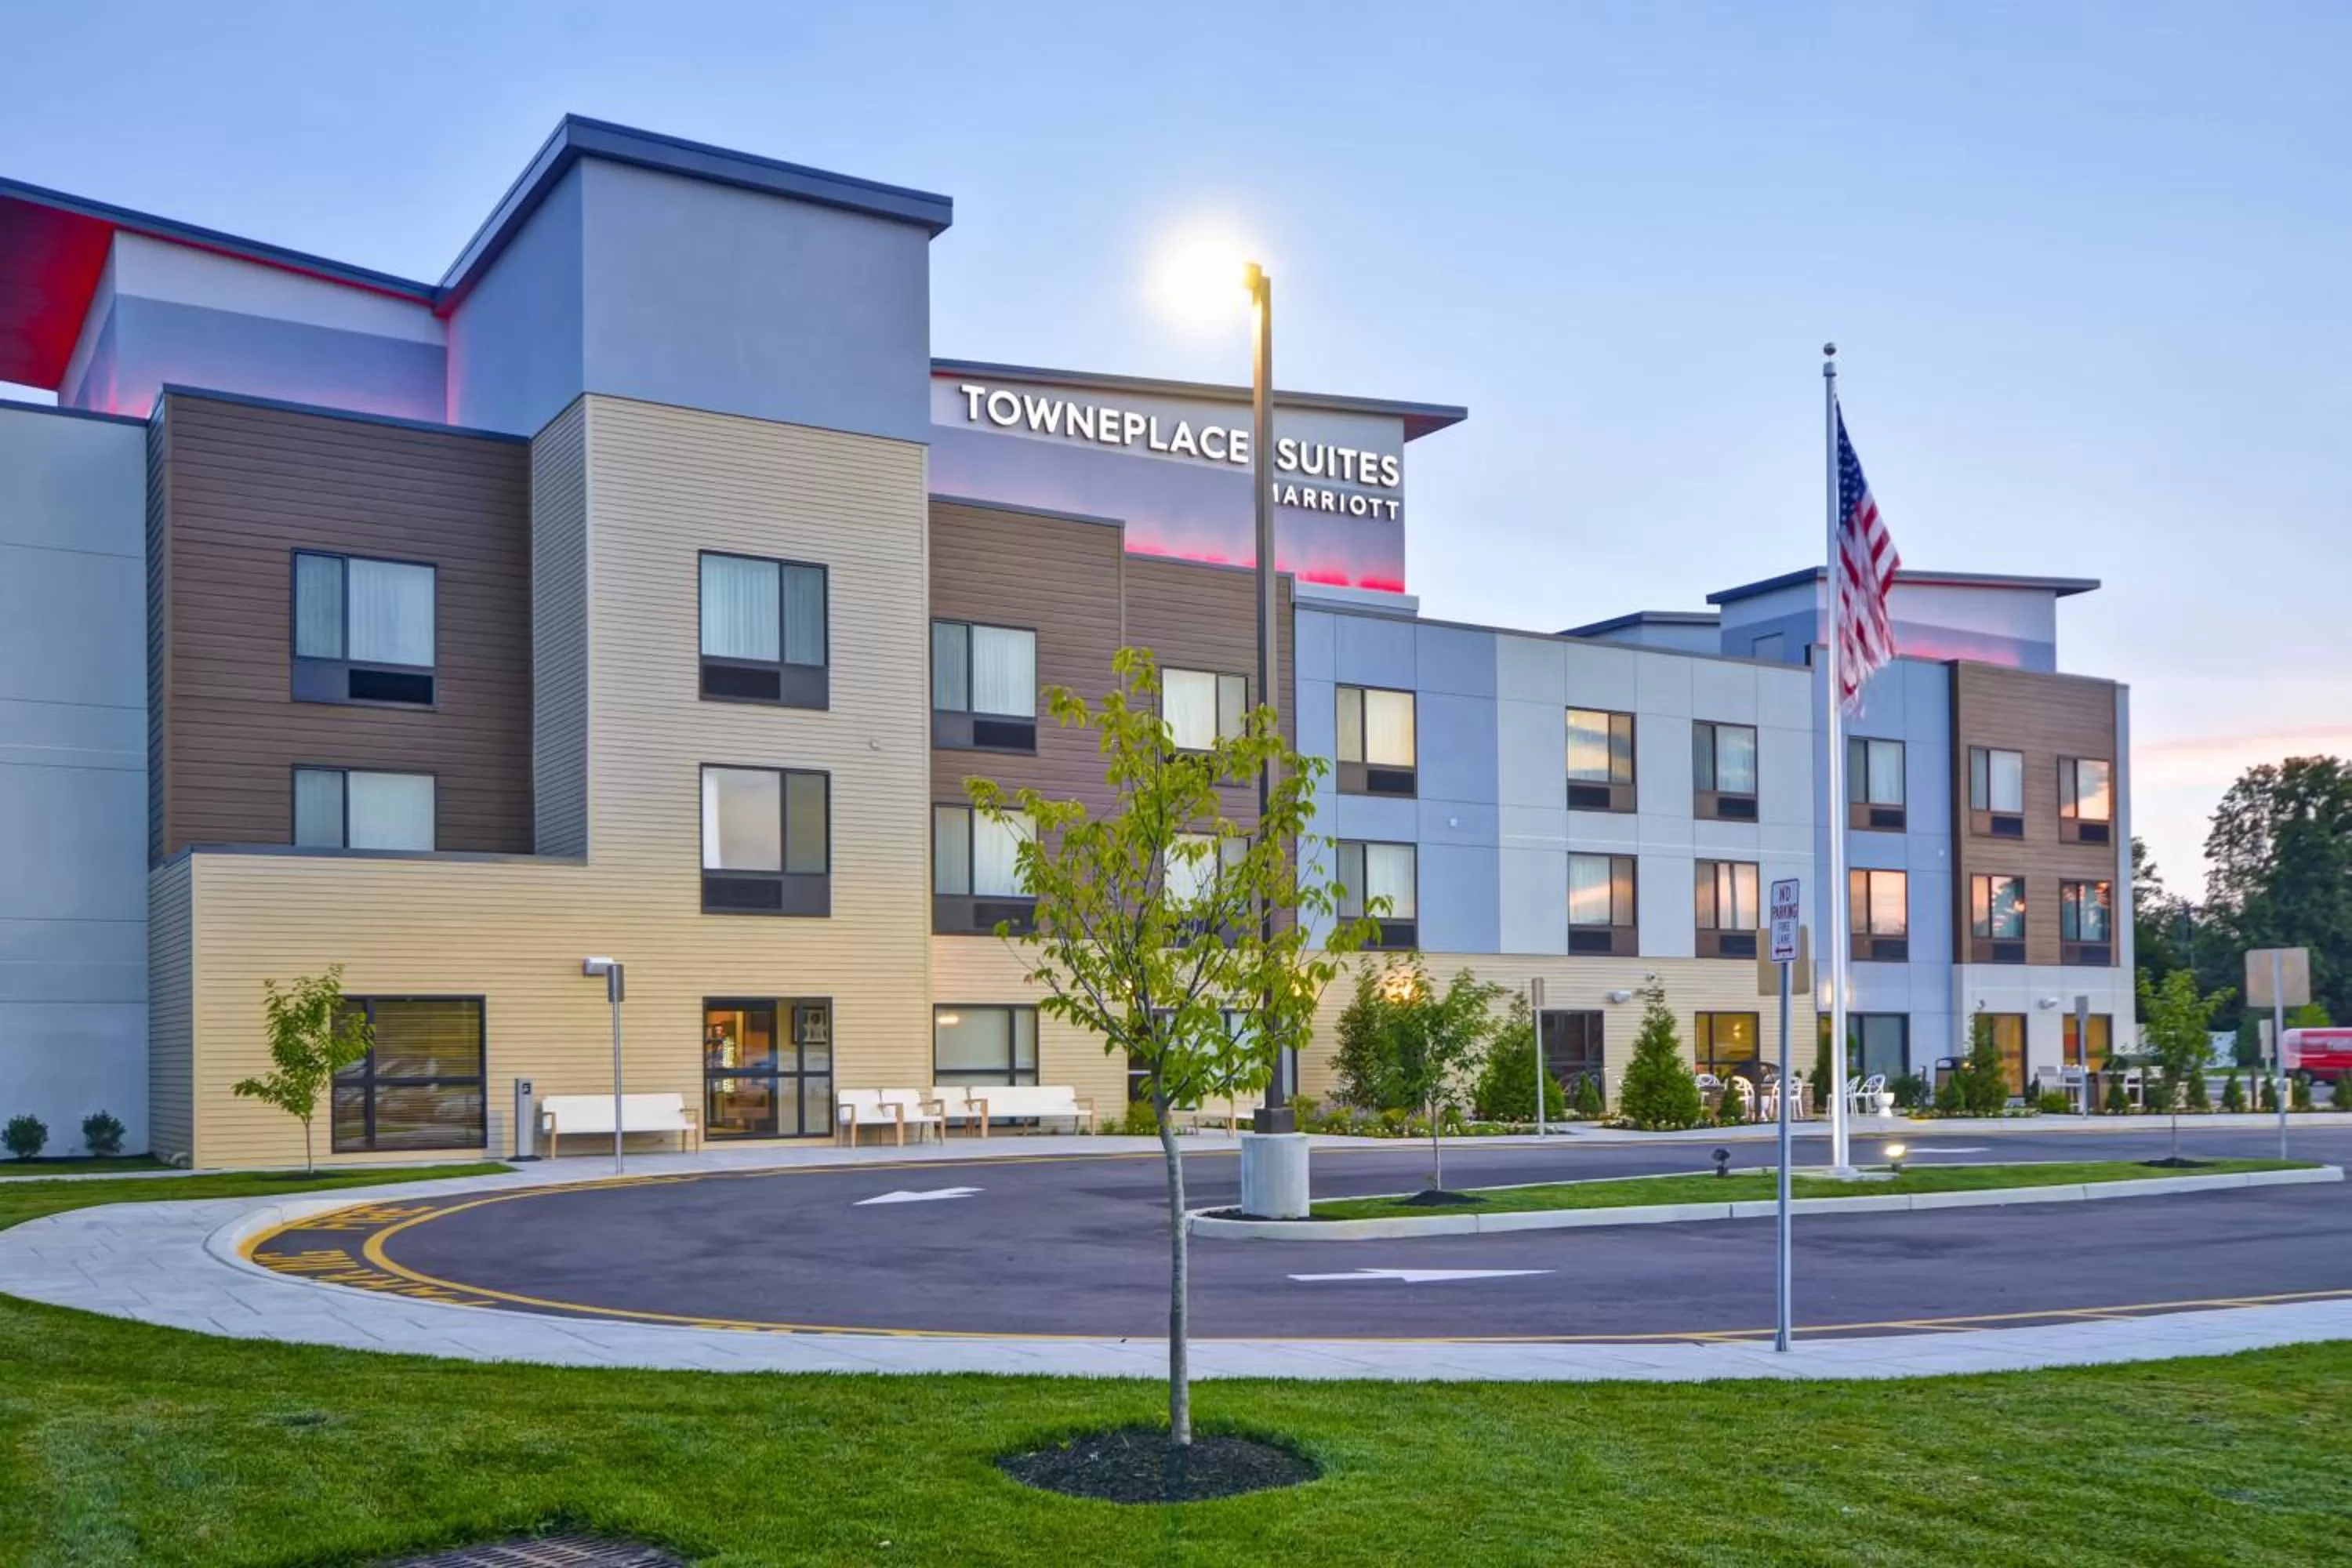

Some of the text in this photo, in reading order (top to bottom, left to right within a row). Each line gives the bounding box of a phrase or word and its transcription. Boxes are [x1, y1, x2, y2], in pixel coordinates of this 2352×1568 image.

[960, 384, 1400, 488] TOWNEPLACE SUITES
[1778, 885, 1792, 902] NO
[1772, 905, 1798, 920] PARKING
